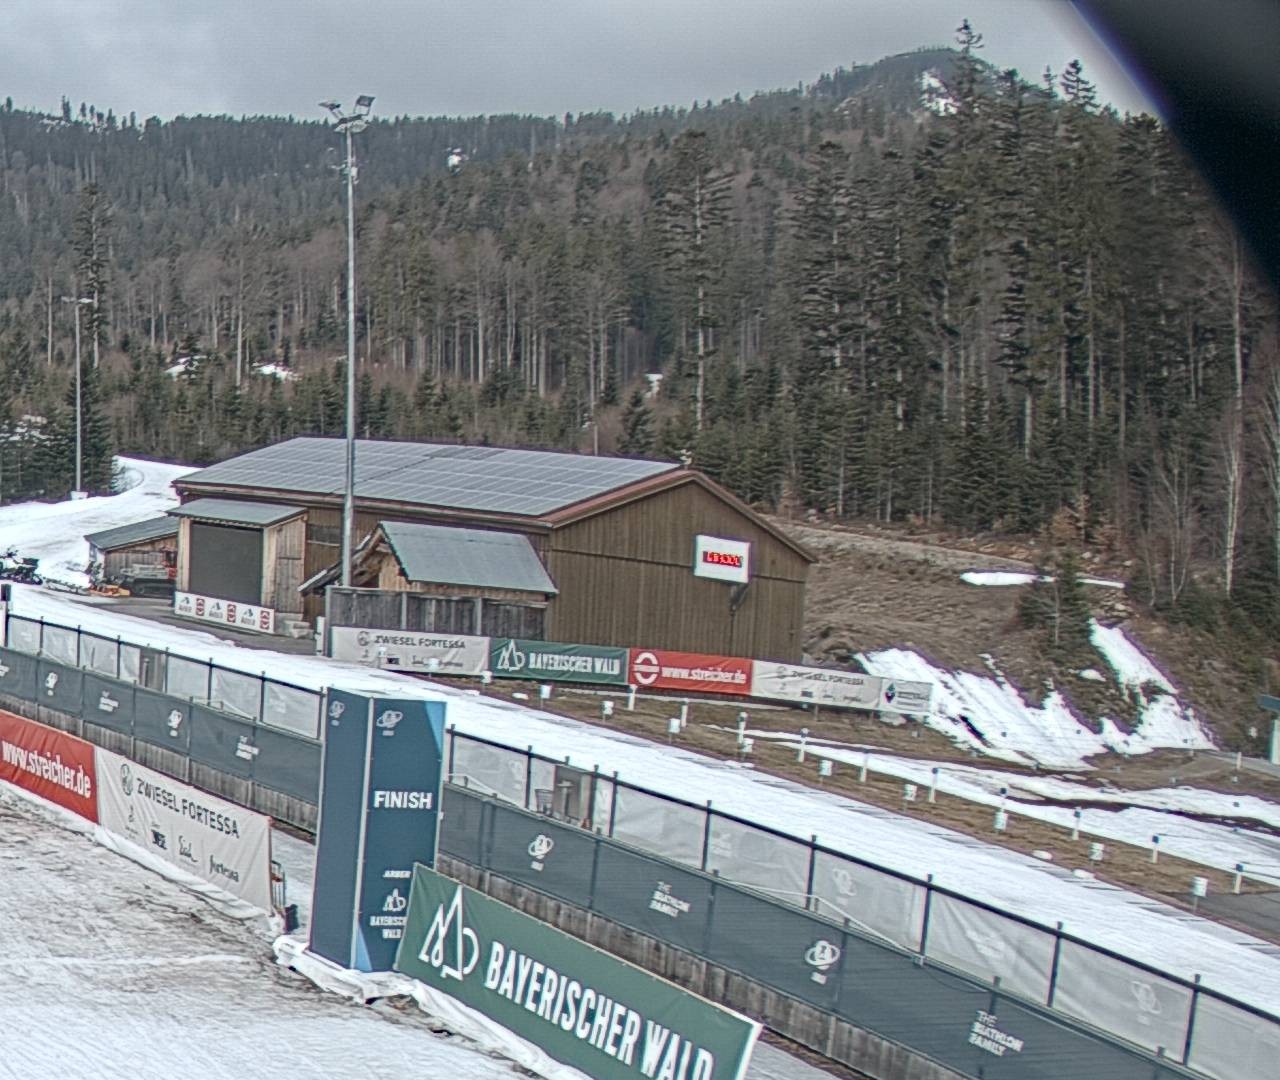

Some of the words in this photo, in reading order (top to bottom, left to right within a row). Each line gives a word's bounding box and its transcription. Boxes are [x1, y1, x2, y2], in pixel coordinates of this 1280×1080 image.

[528, 652, 593, 674] BAYERISCHER
[594, 656, 621, 675] WALD
[1, 739, 92, 799] www.streicher.de
[136, 777, 180, 813] ZWIESEL
[181, 798, 240, 839] FORTESSA
[373, 790, 433, 810] FINISH
[484, 941, 641, 1066] BAYERISCHER
